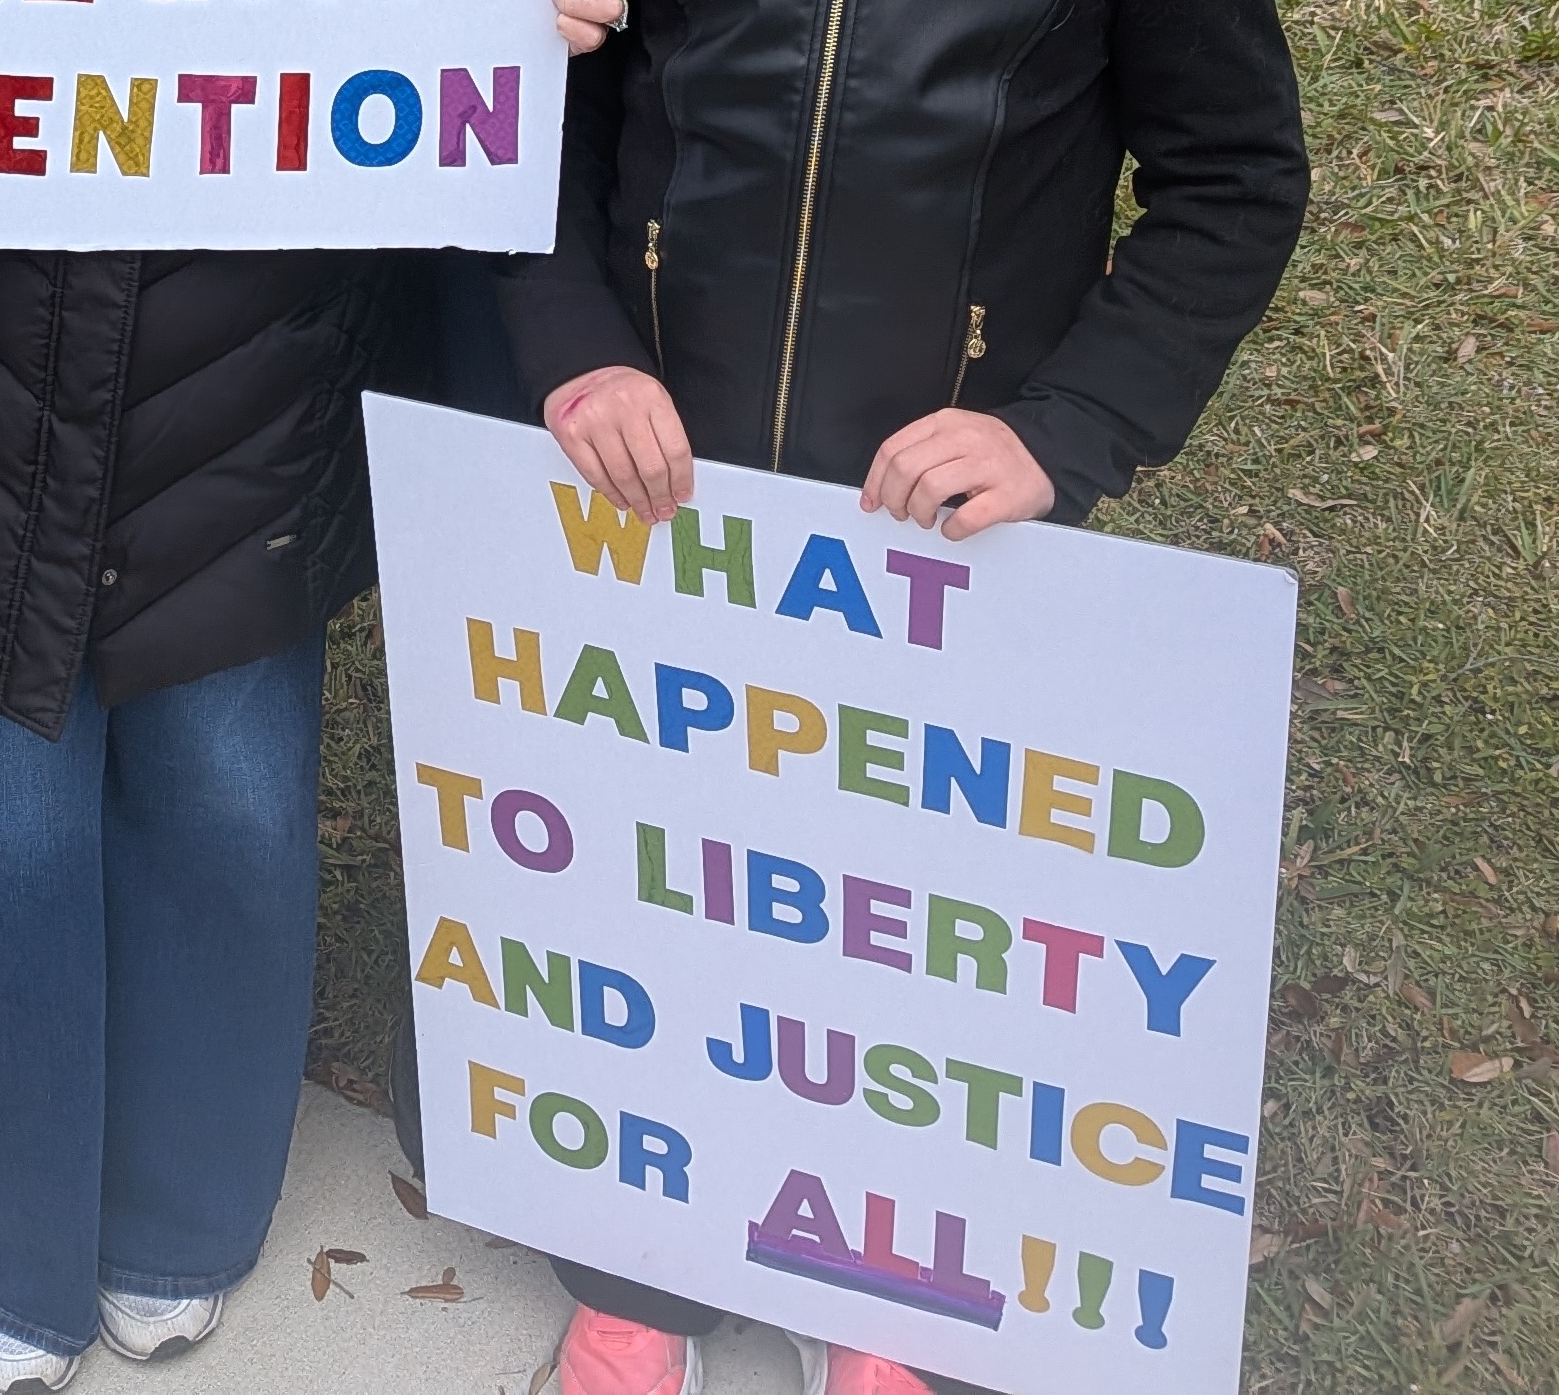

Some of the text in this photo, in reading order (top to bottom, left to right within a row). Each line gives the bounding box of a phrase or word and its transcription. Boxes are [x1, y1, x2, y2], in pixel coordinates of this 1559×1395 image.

[549, 480, 971, 651] WHAT
[466, 617, 1207, 869] HAPPENED
[416, 762, 1217, 1038] TO LIBERTY
[414, 916, 1249, 1217] AND JUSTICE
[468, 1060, 693, 1205] FOR
